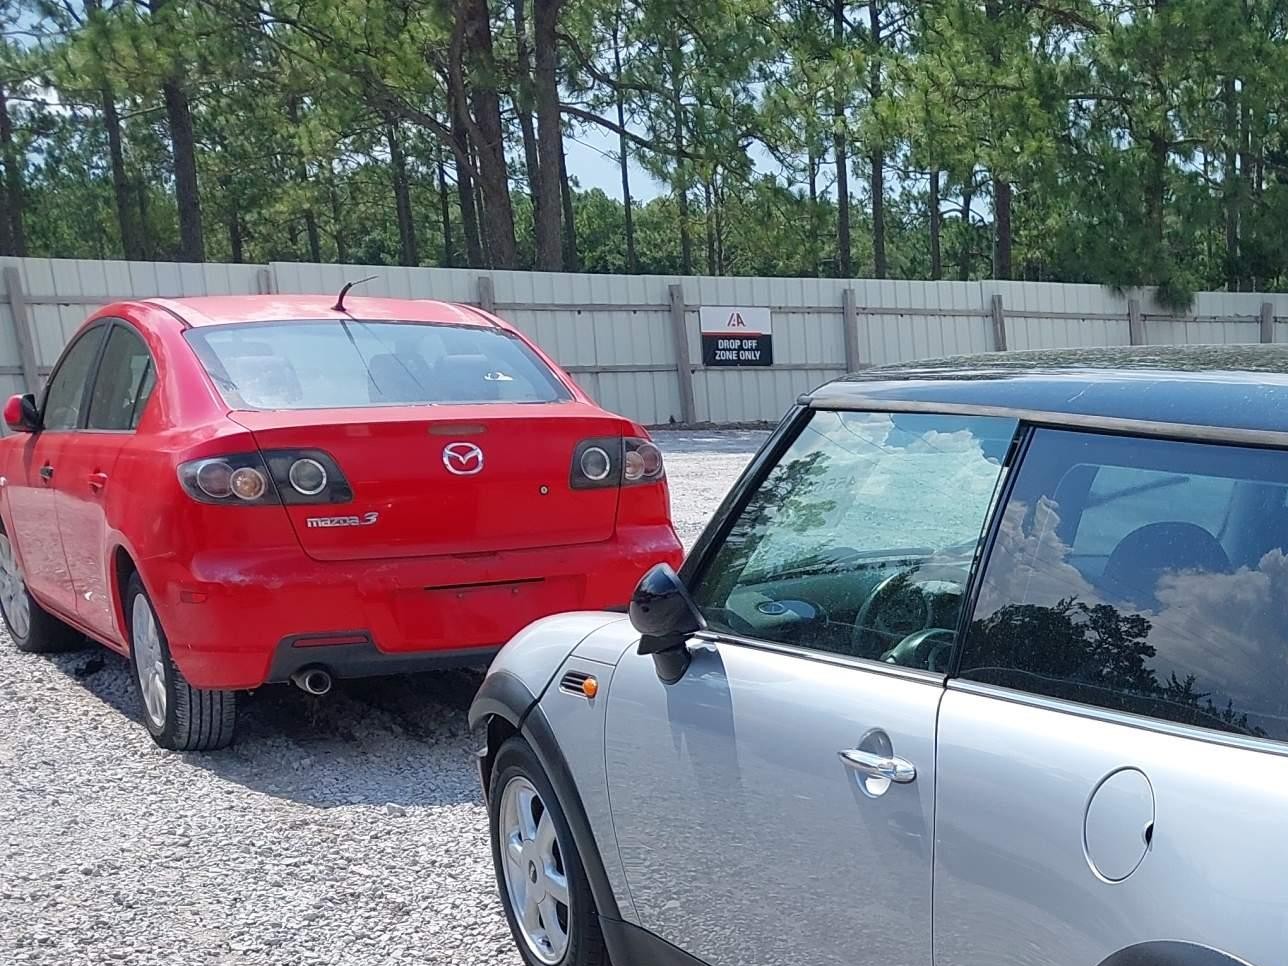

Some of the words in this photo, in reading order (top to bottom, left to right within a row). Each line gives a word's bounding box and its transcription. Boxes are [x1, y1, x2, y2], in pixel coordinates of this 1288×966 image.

[718, 339, 740, 349] DROP
[742, 339, 758, 349] OFF
[715, 350, 738, 360] ZONE
[739, 350, 760, 360] ONLY
